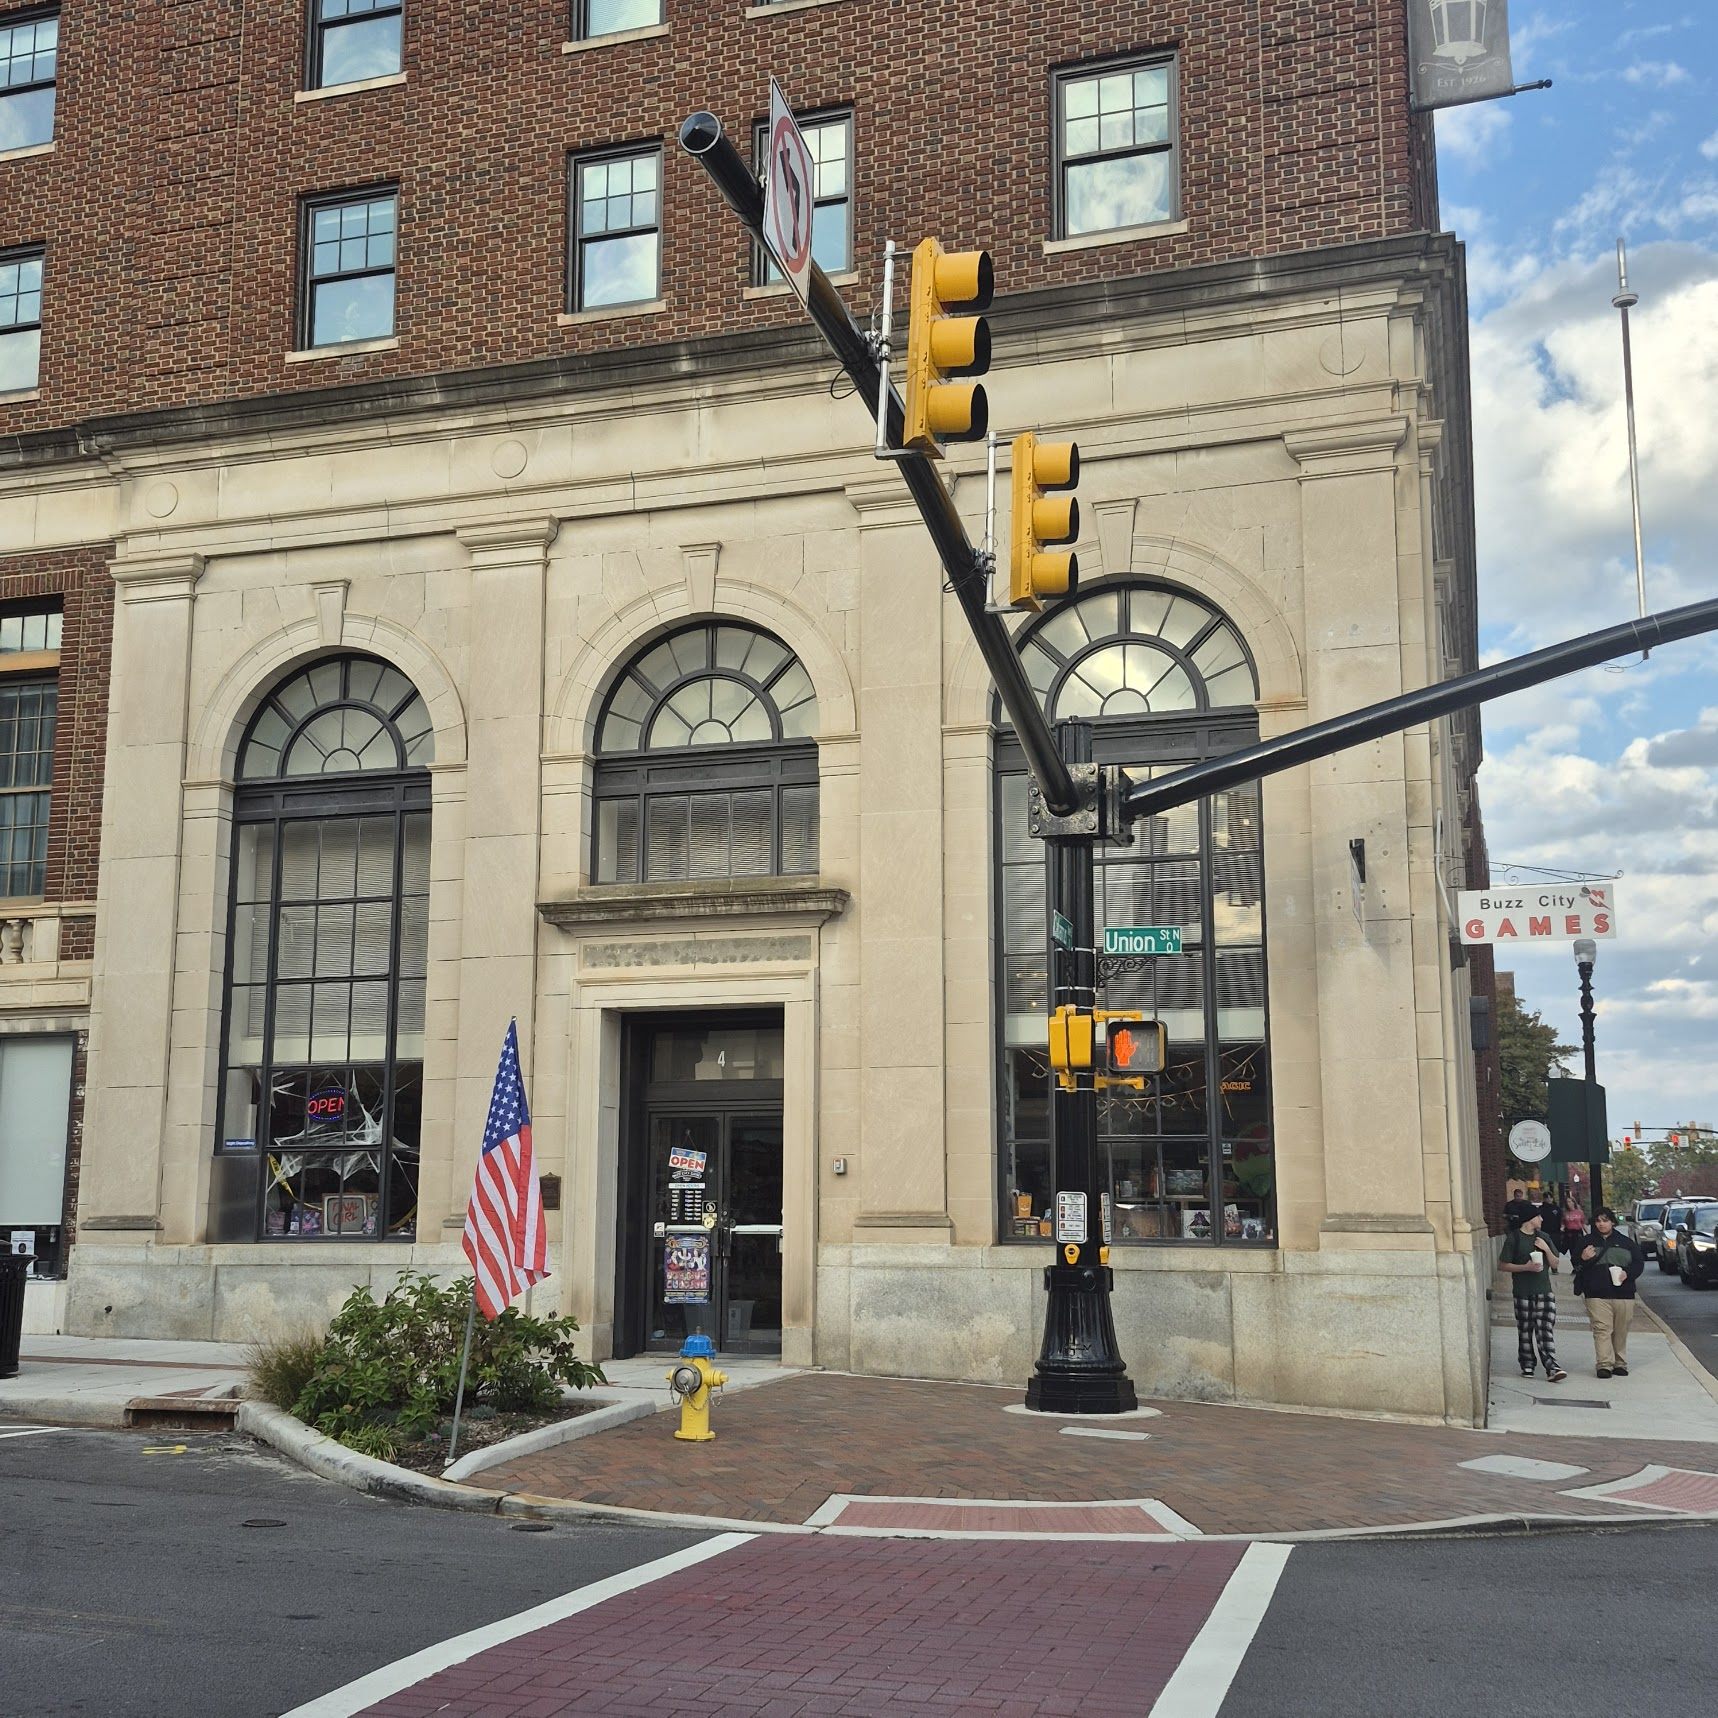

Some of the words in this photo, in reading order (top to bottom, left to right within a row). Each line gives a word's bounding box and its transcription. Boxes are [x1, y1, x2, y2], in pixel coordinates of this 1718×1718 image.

[1480, 898, 1524, 910] Buzz
[1538, 895, 1575, 909] City
[1465, 913, 1610, 939] GAMES
[1105, 931, 1156, 952] Union
[1160, 929, 1170, 940] St
[1172, 930, 1180, 940] N
[717, 1050, 726, 1067] 4
[308, 1097, 345, 1114] OPEN
[671, 1156, 704, 1170] OPEN
[333, 1201, 359, 1212] FNAL
